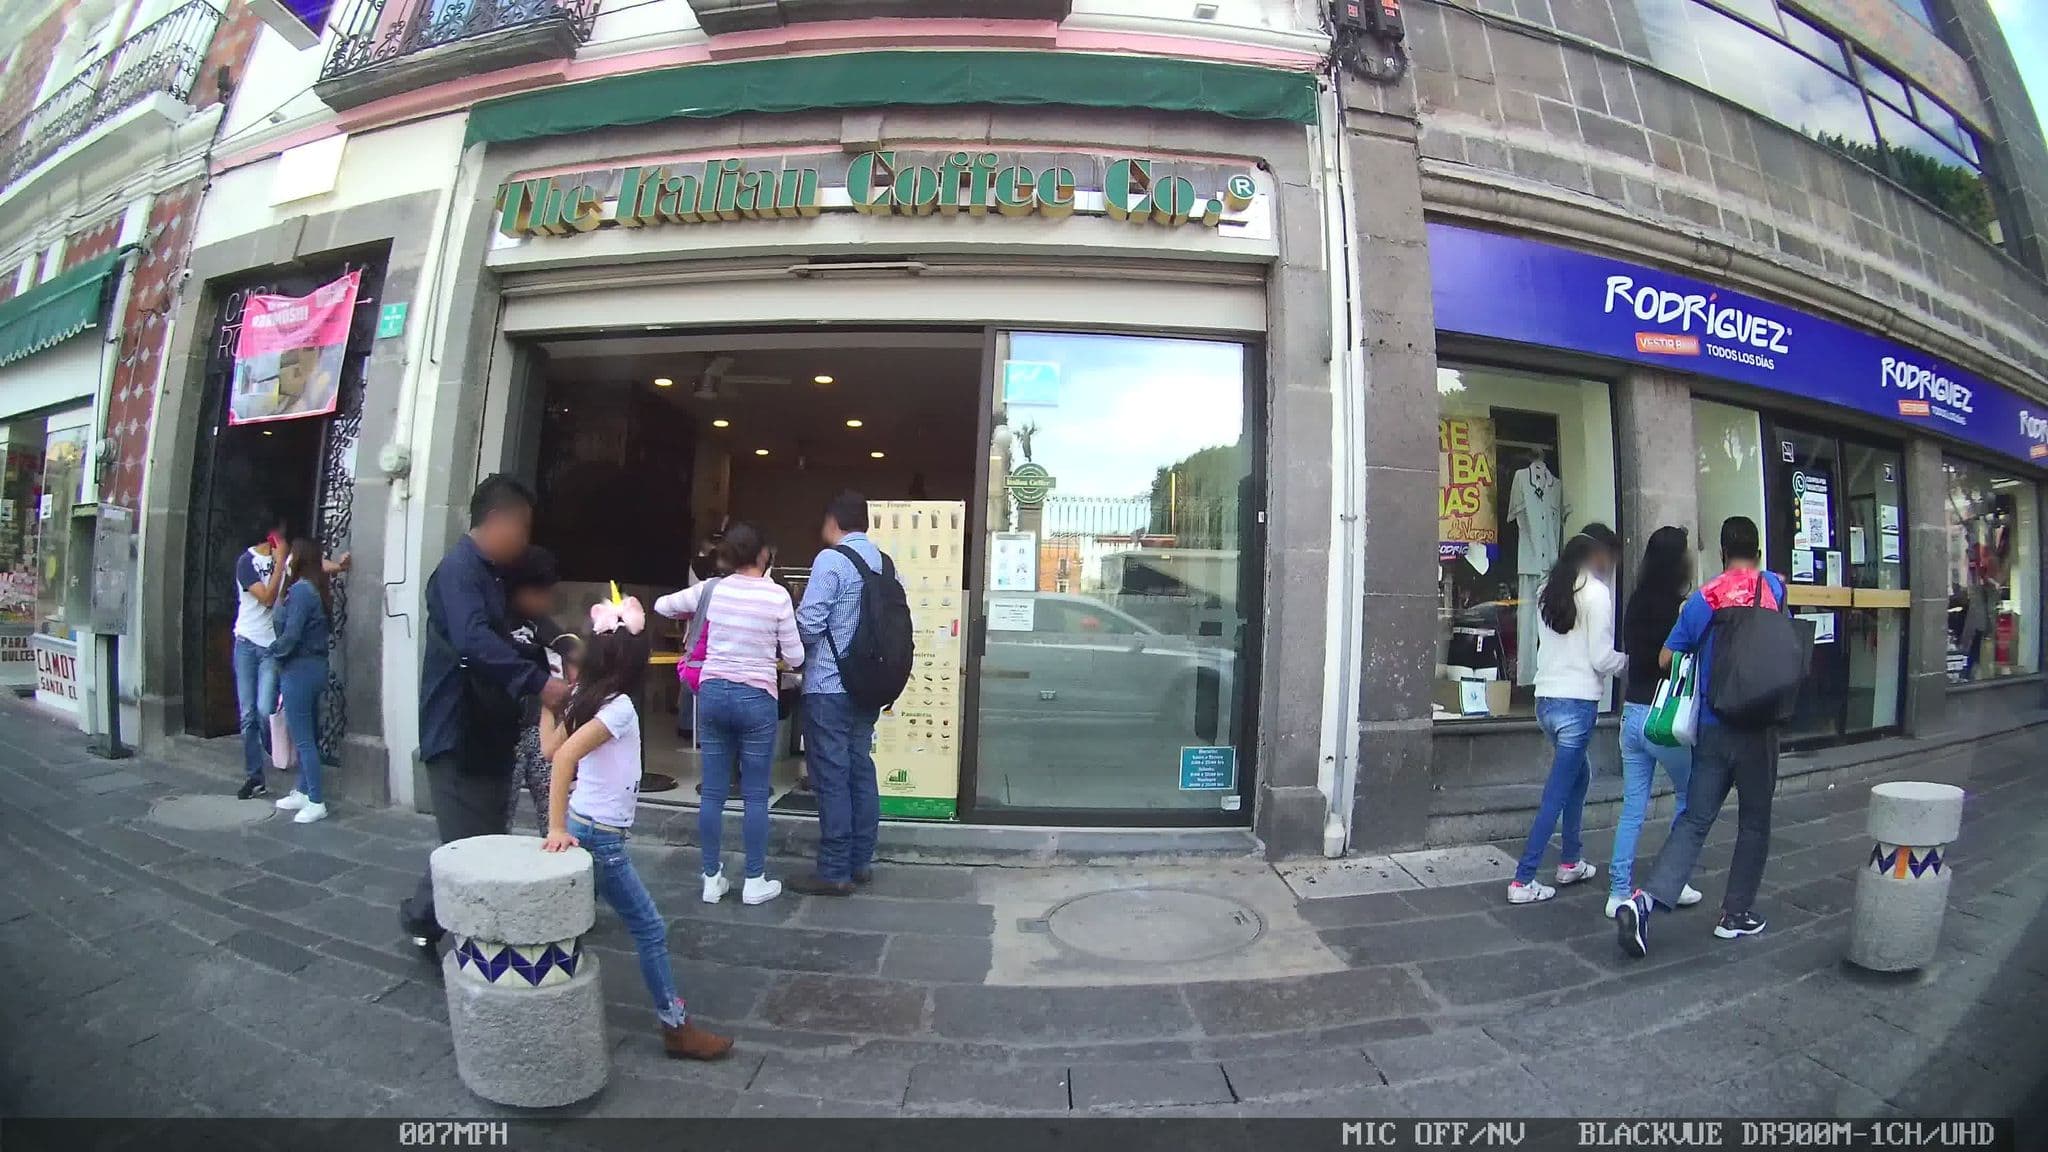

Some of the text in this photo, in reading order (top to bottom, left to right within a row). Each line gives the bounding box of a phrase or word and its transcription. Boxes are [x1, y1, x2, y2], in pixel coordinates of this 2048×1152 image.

[498, 177, 600, 236] The
[617, 158, 819, 227] Italian
[846, 150, 1076, 215] Coffee
[1104, 158, 1223, 226] Co.
[1706, 343, 1737, 361] TODOS
[1738, 350, 1755, 366] LOS
[1, 636, 28, 648] PARA
[1, 650, 36, 662] DULCES
[37, 648, 77, 681] CAMOT
[40, 676, 65, 696] SANTA
